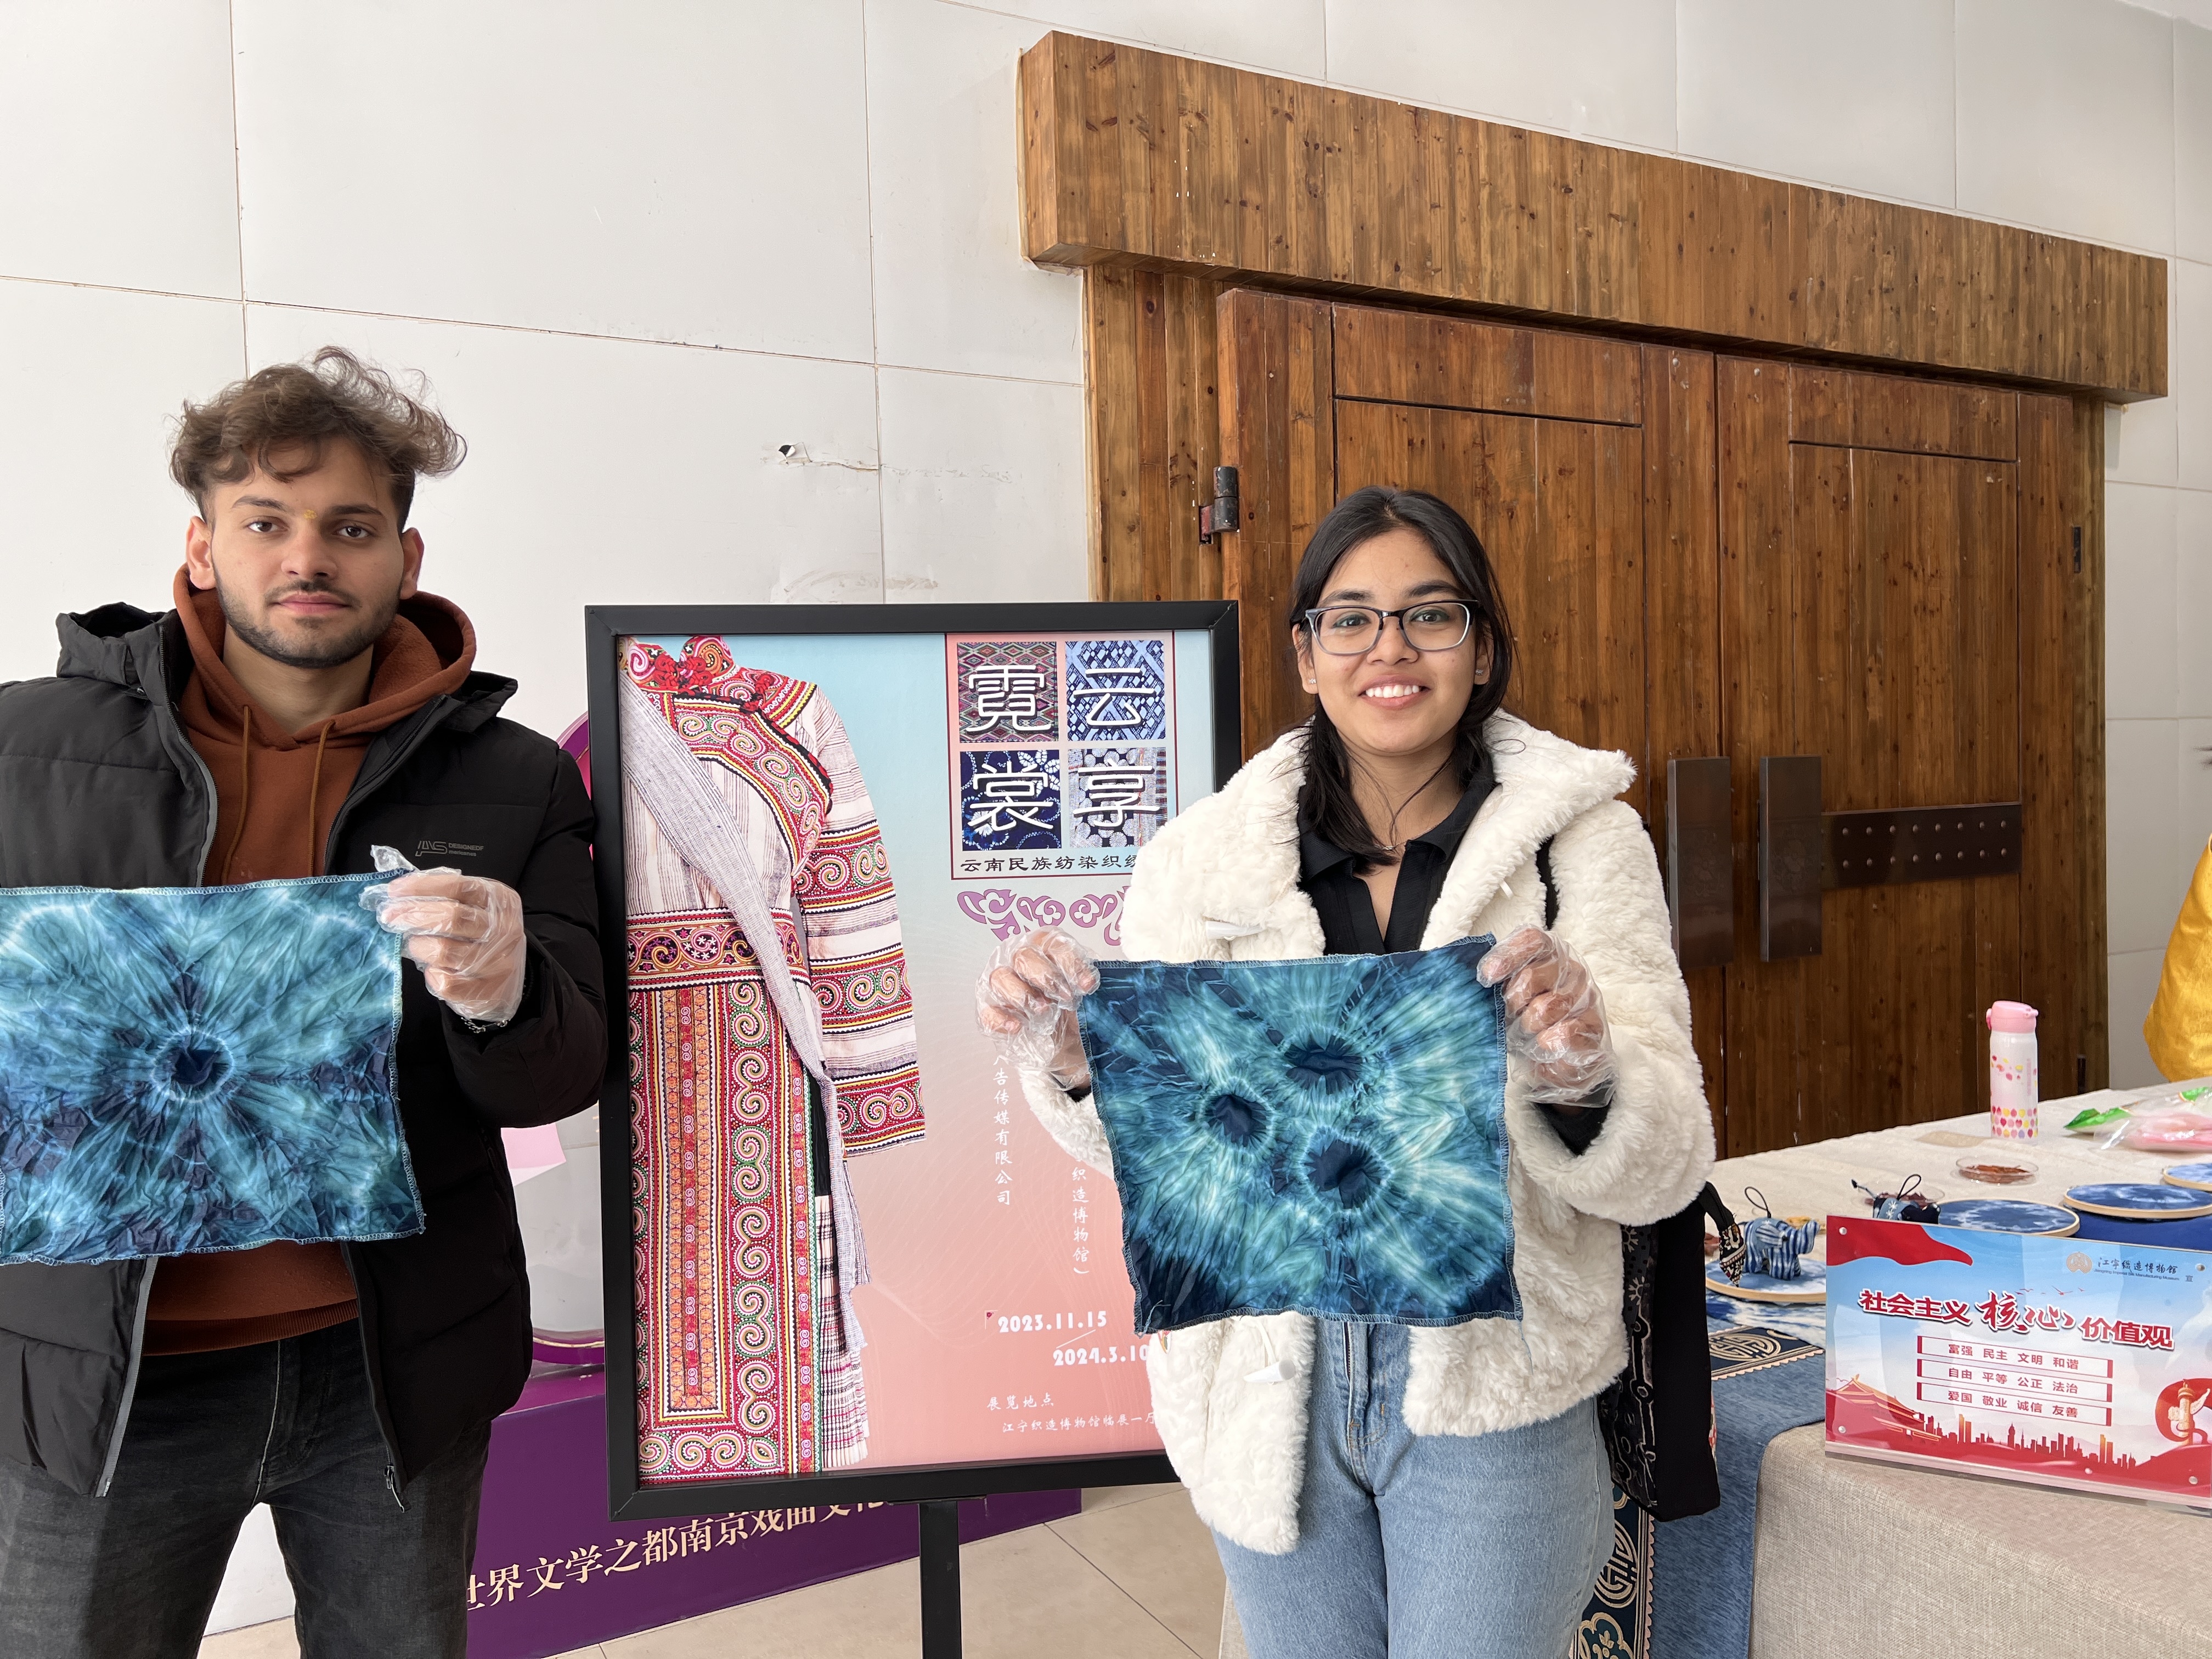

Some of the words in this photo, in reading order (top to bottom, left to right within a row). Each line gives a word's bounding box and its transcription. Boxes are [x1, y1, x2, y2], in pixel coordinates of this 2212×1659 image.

[992, 1055, 1013, 1206] 告传媒有限公司
[997, 1310, 1108, 1333] 2023.11.15
[1053, 1344, 1148, 1367] 2024.3.10
[1948, 1344, 1973, 1357] 富强
[1983, 1348, 2008, 1362] 民主
[2018, 1353, 2043, 1366] 文明
[2053, 1357, 2079, 1370] 和谐
[1949, 1368, 1973, 1381] 自由
[1982, 1372, 2007, 1385] 平等
[2018, 1377, 2043, 1390] 公正
[2052, 1381, 2078, 1395] 法治
[986, 1392, 1054, 1411] 展览地点
[1948, 1391, 1973, 1404] 爱国
[1982, 1395, 2007, 1409] 敬业
[2017, 1400, 2042, 1413] 诚信
[2052, 1404, 2078, 1418] 友善
